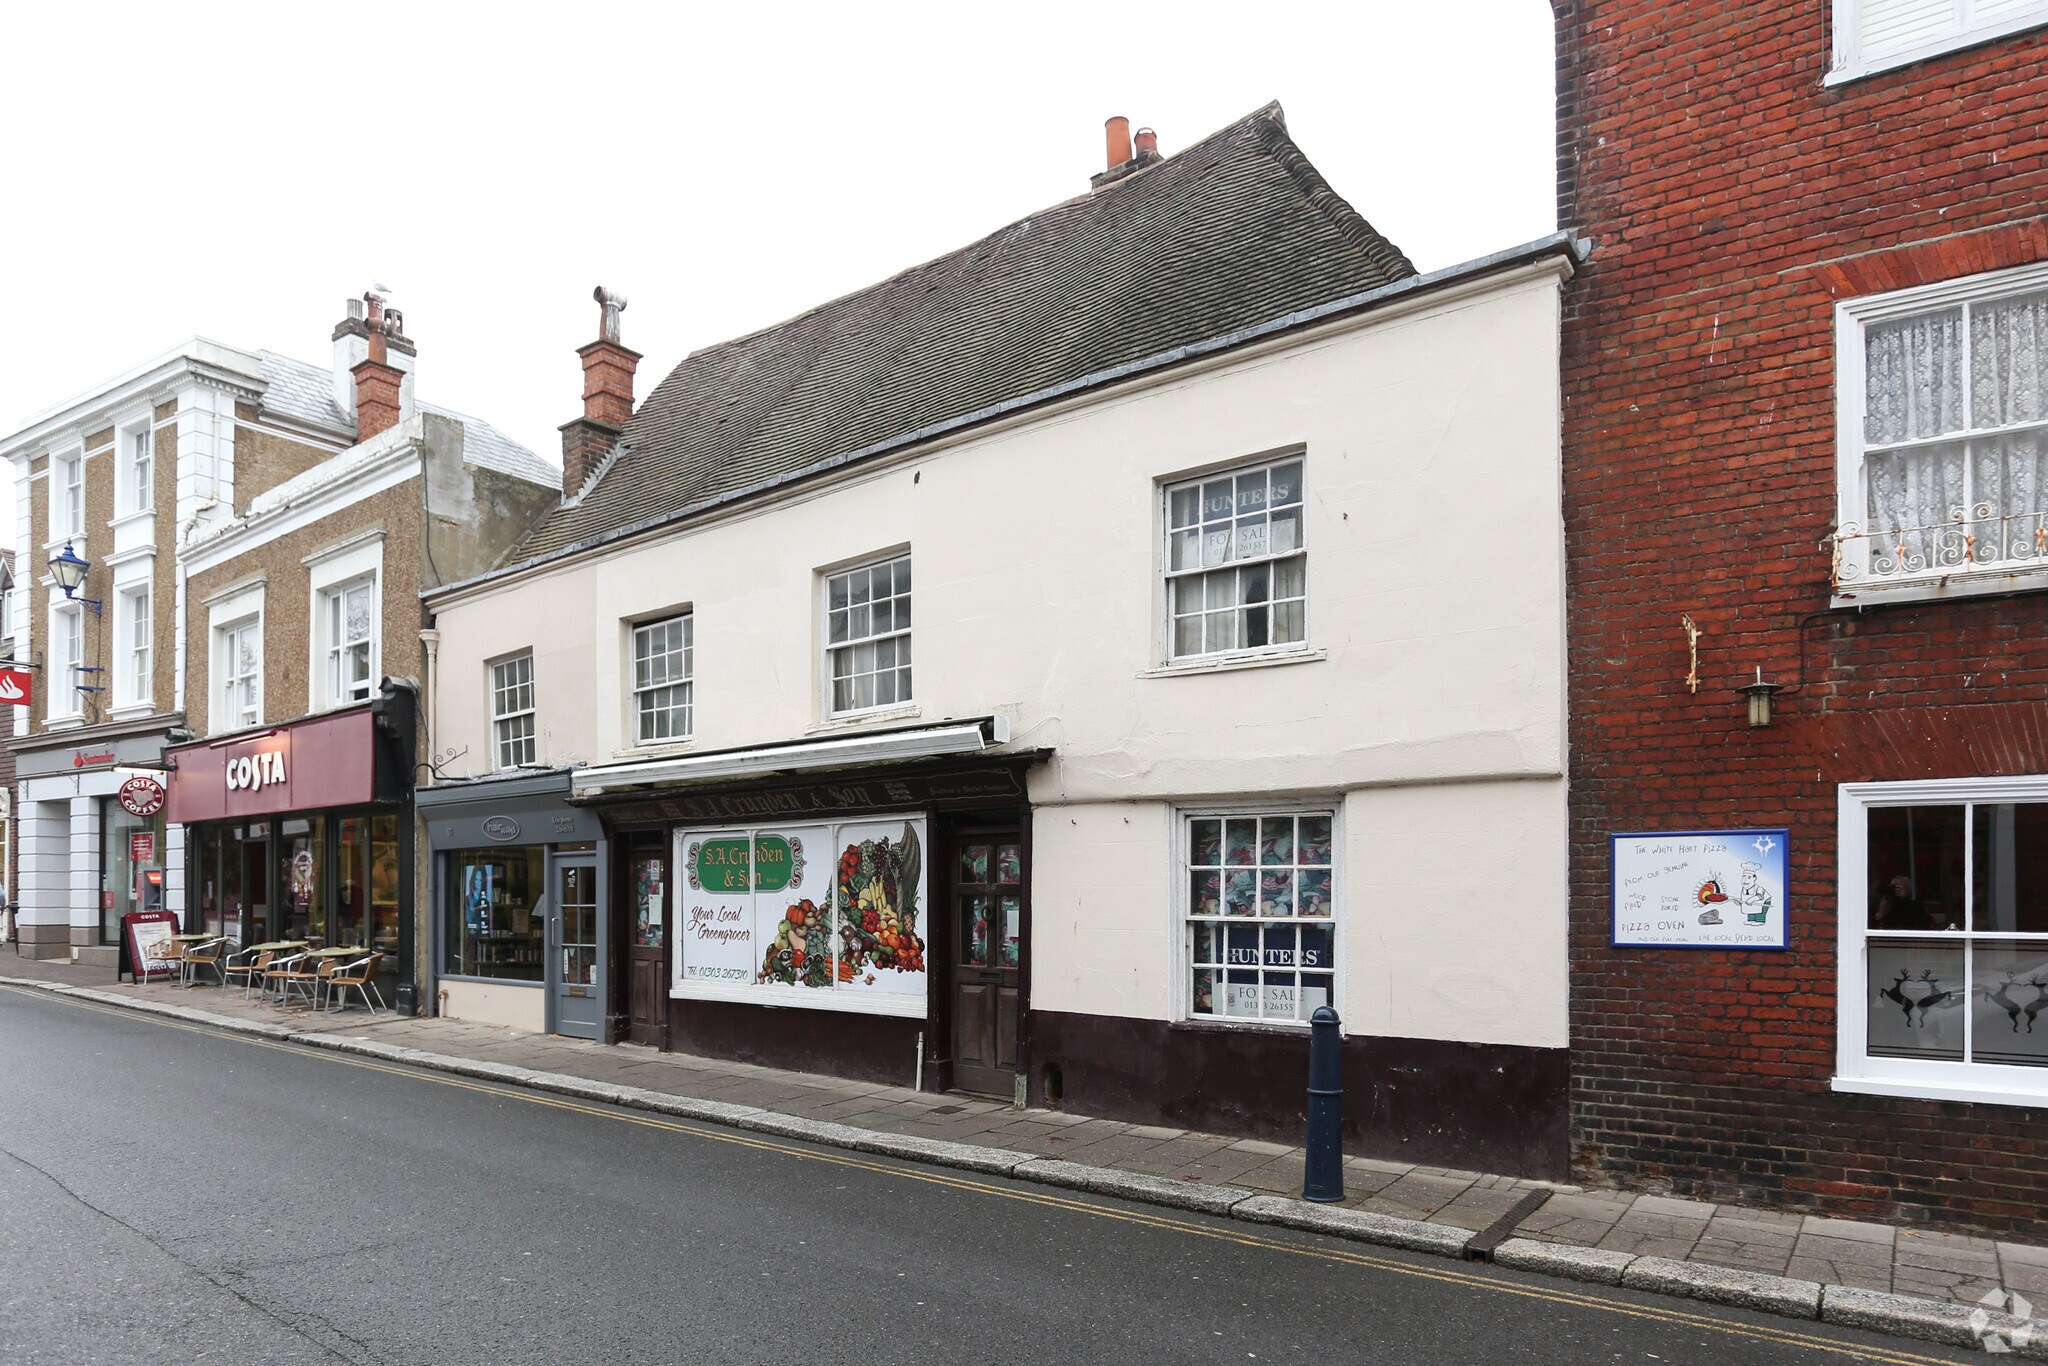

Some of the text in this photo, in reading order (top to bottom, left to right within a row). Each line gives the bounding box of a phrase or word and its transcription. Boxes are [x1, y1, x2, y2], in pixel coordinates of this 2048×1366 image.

[1197, 484, 1289, 515] HUNTERS
[1241, 527, 1266, 541] SAL
[226, 751, 286, 791] COSTA
[127, 780, 157, 792] COSTA
[828, 784, 873, 807] Son
[125, 799, 161, 813] COFFEE
[724, 869, 735, 887] &
[686, 905, 742, 931] Your Local
[1658, 921, 1685, 930] OVEN
[698, 923, 750, 945] Greengrocer
[1225, 948, 1318, 965] HUNTERS
[699, 967, 721, 978] 01303
[722, 968, 748, 980] 267310
[1239, 987, 1266, 999] FO
[1244, 1001, 1296, 1011] 0133 26155
